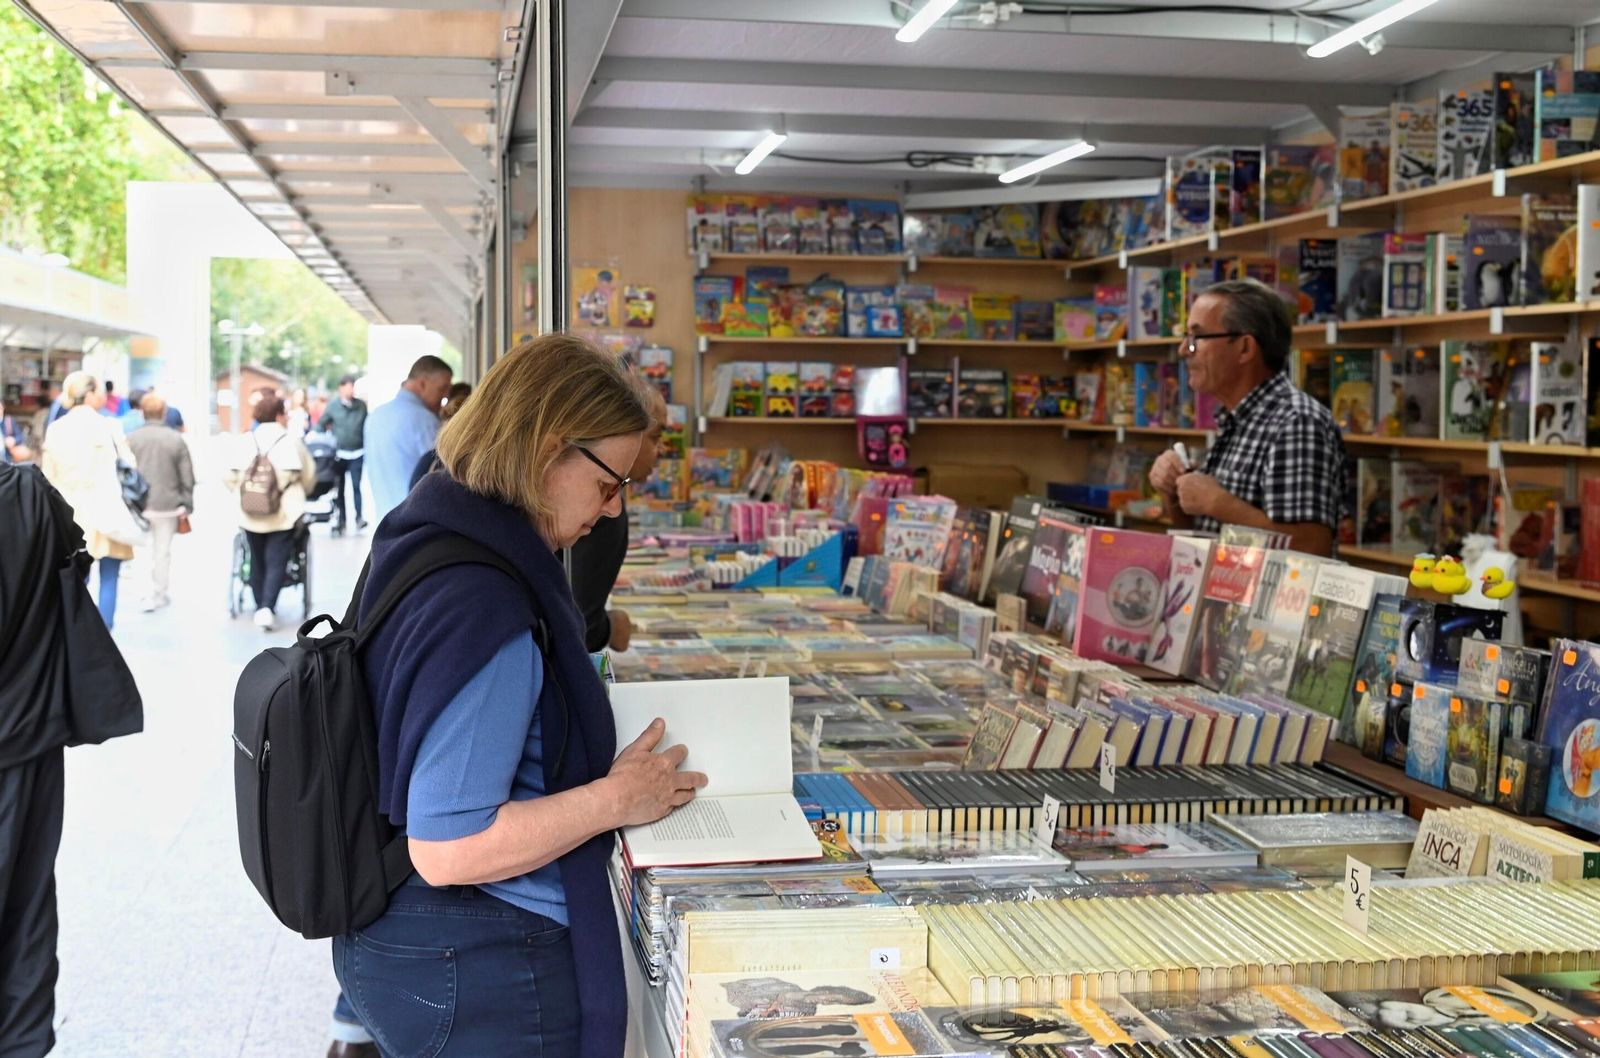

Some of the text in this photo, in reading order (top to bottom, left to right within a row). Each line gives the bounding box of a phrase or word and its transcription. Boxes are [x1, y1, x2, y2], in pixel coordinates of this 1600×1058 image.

[1457, 98, 1493, 118] 365
[1104, 749, 1109, 766] 5
[1044, 803, 1050, 822] 5
[1422, 832, 1461, 870] INCA
[1350, 867, 1366, 911] 5 €
